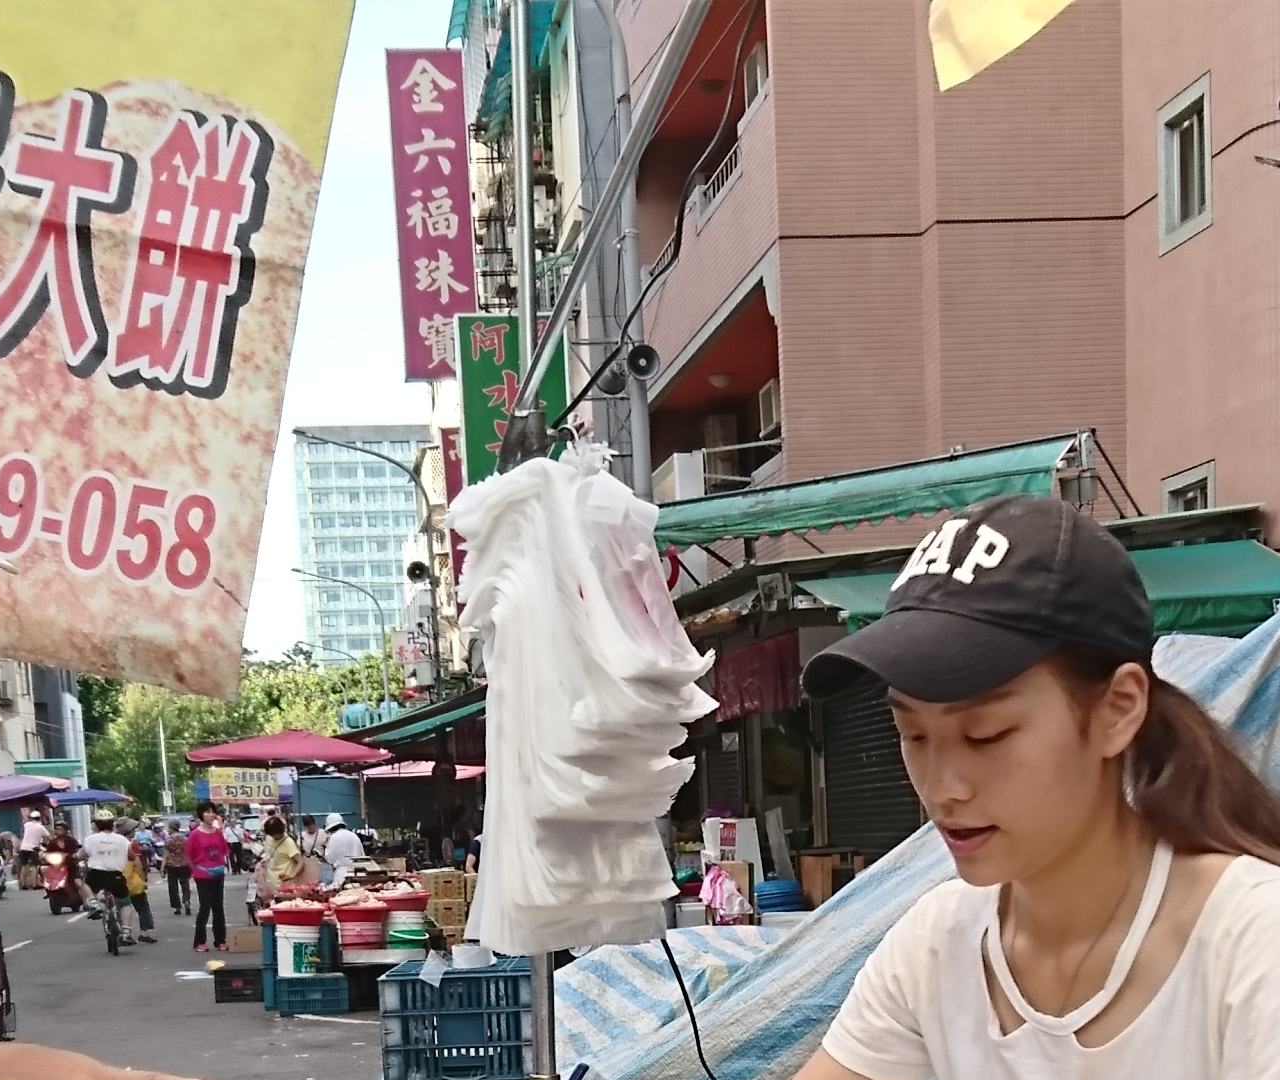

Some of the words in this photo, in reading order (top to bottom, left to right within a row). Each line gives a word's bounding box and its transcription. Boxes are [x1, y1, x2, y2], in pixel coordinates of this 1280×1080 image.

[400, 58, 469, 369] 金六福珠寶
